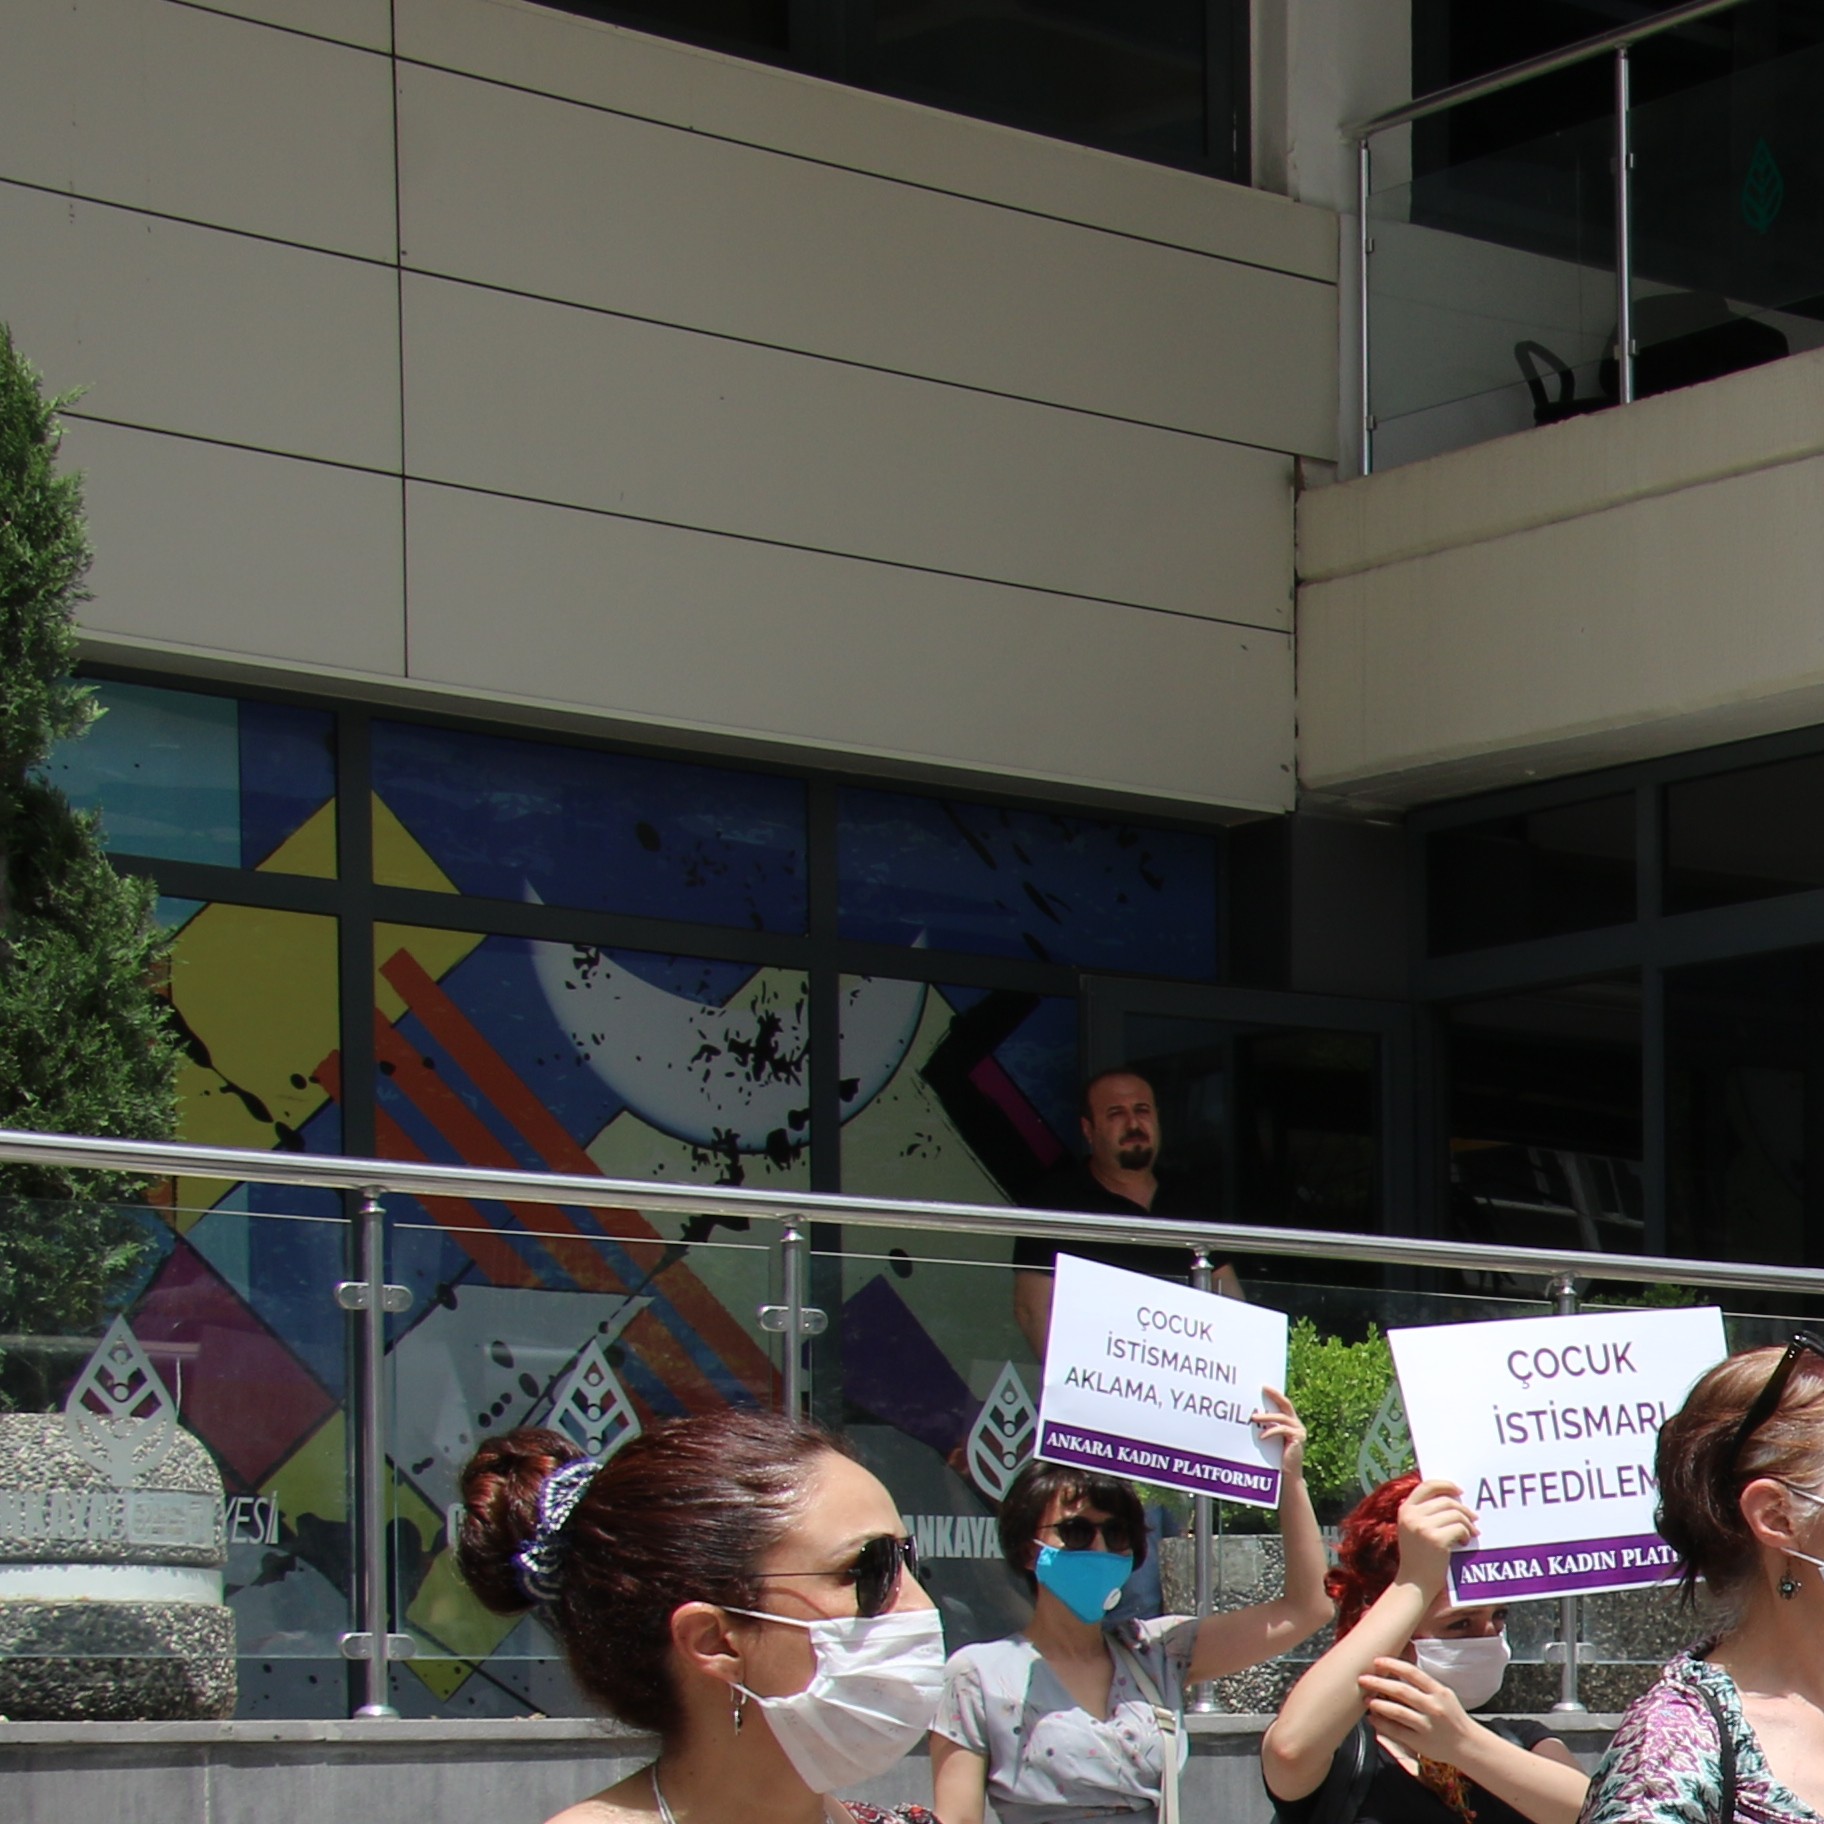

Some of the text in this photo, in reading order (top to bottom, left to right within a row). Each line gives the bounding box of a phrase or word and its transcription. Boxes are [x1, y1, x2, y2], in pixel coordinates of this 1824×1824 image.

[1136, 1306, 1214, 1343] ÇOCUK
[1106, 1331, 1237, 1386] İSTİSMARINI
[1507, 1341, 1638, 1389] ÇOCUK
[1064, 1366, 1163, 1409] AKLAMA,
[1046, 1431, 1273, 1492] ANKARA KADIN PLATFORMU
[1460, 1558, 1543, 1585] ANKARA
[1548, 1550, 1616, 1575] KADIN
